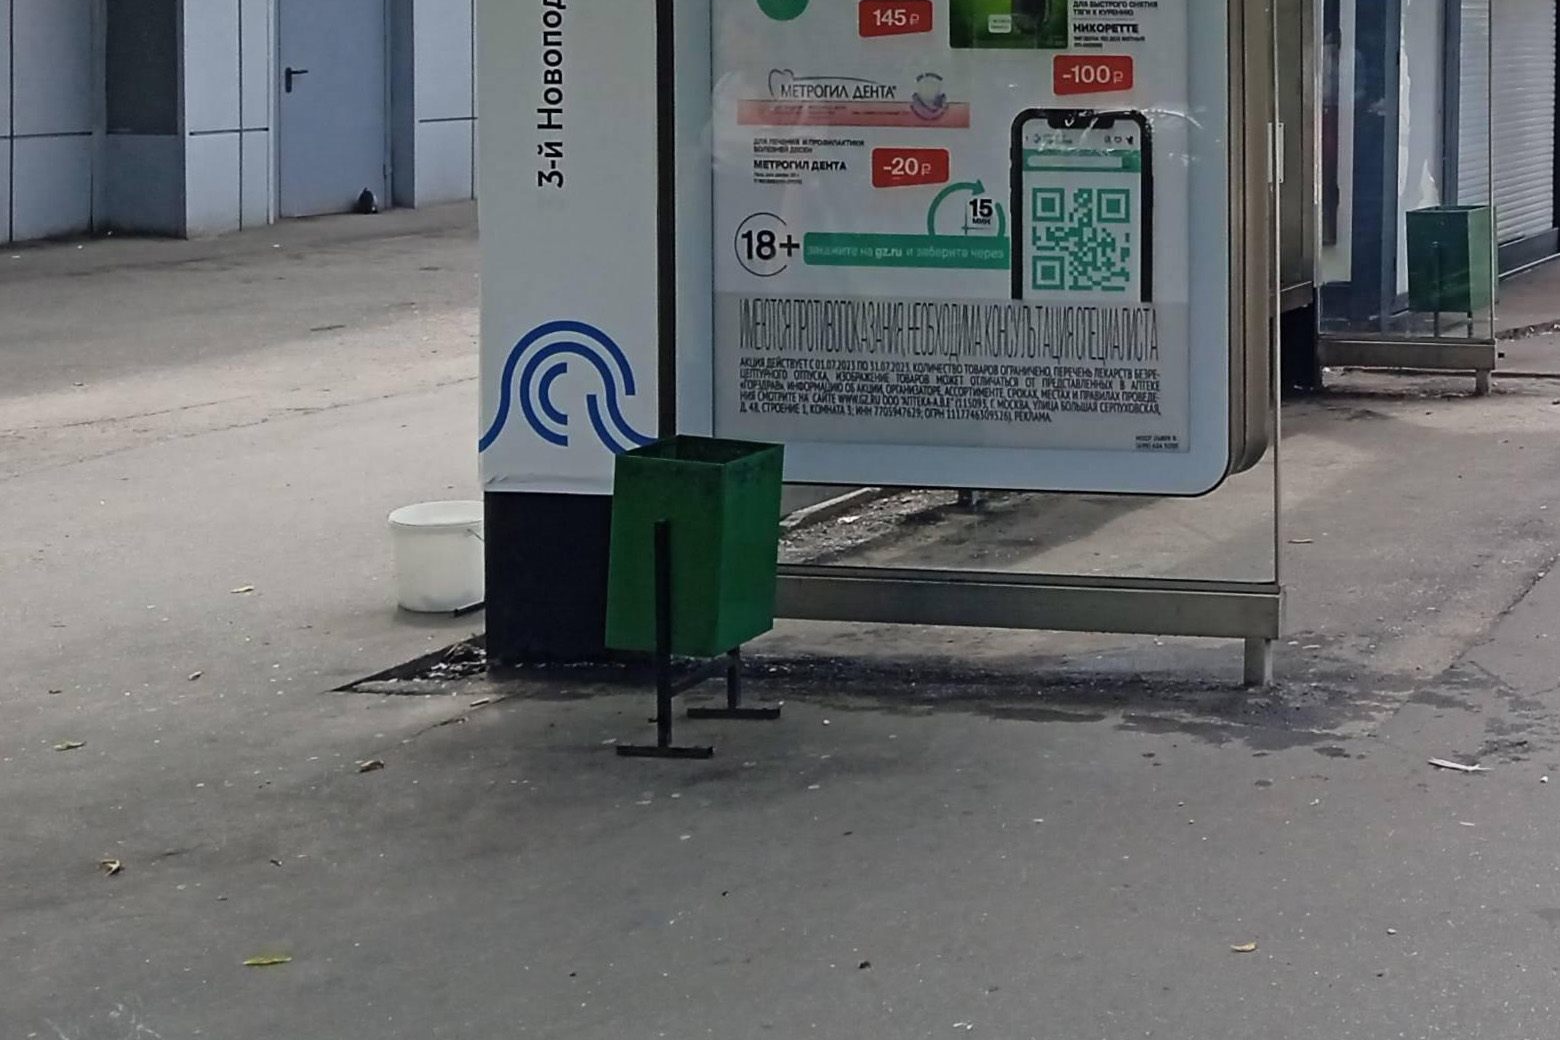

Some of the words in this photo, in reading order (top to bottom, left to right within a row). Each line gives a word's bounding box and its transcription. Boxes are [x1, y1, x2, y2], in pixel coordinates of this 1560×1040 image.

[873, 9, 907, 27] 145
[1073, 23, 1139, 33] НИКОРЕТТЕ
[781, 83, 849, 99] МЕТРОГИЛ
[538, 139, 563, 188] 3-й
[753, 160, 810, 171] МЕТРОГИЛ
[811, 161, 847, 171] ДЕНТА
[969, 198, 993, 217] 15
[741, 229, 801, 261] 18+
[875, 248, 903, 260] gz.ru
[740, 298, 791, 350] ИМЕЮТСЯ
[907, 302, 982, 365] НЕОБХОДИМА
[985, 305, 1074, 364] КОНСУЛЬТАЦИЯ
[1075, 307, 1159, 365] СПЕЦИАЛИСТА
[740, 357, 765, 369] АКЦИЯ
[766, 357, 808, 370] ДЕЙСТВУЕТ
[857, 360, 868, 371] ПО
[912, 363, 963, 374] КОЛИЧЕСТВО
[964, 364, 999, 375] ТОВАРОВ
[1053, 367, 1093, 378] ПЕРЕЧЕНЬ
[1094, 368, 1133, 379] ЛЕКАРСТВ
[836, 372, 889, 383] ИЗОБРАЖЕНИЕ
[896, 374, 930, 385] ТОВАРОВ
[936, 375, 963, 386] МОЖЕТ
[970, 376, 1019, 387] ОТЛИЧАТЬСЯ
[1025, 377, 1035, 388] ОТ
[1042, 378, 1113, 390] ПРЕДСТАВЛЕННЫХ
[1131, 381, 1160, 391] АПТЕКЕ
